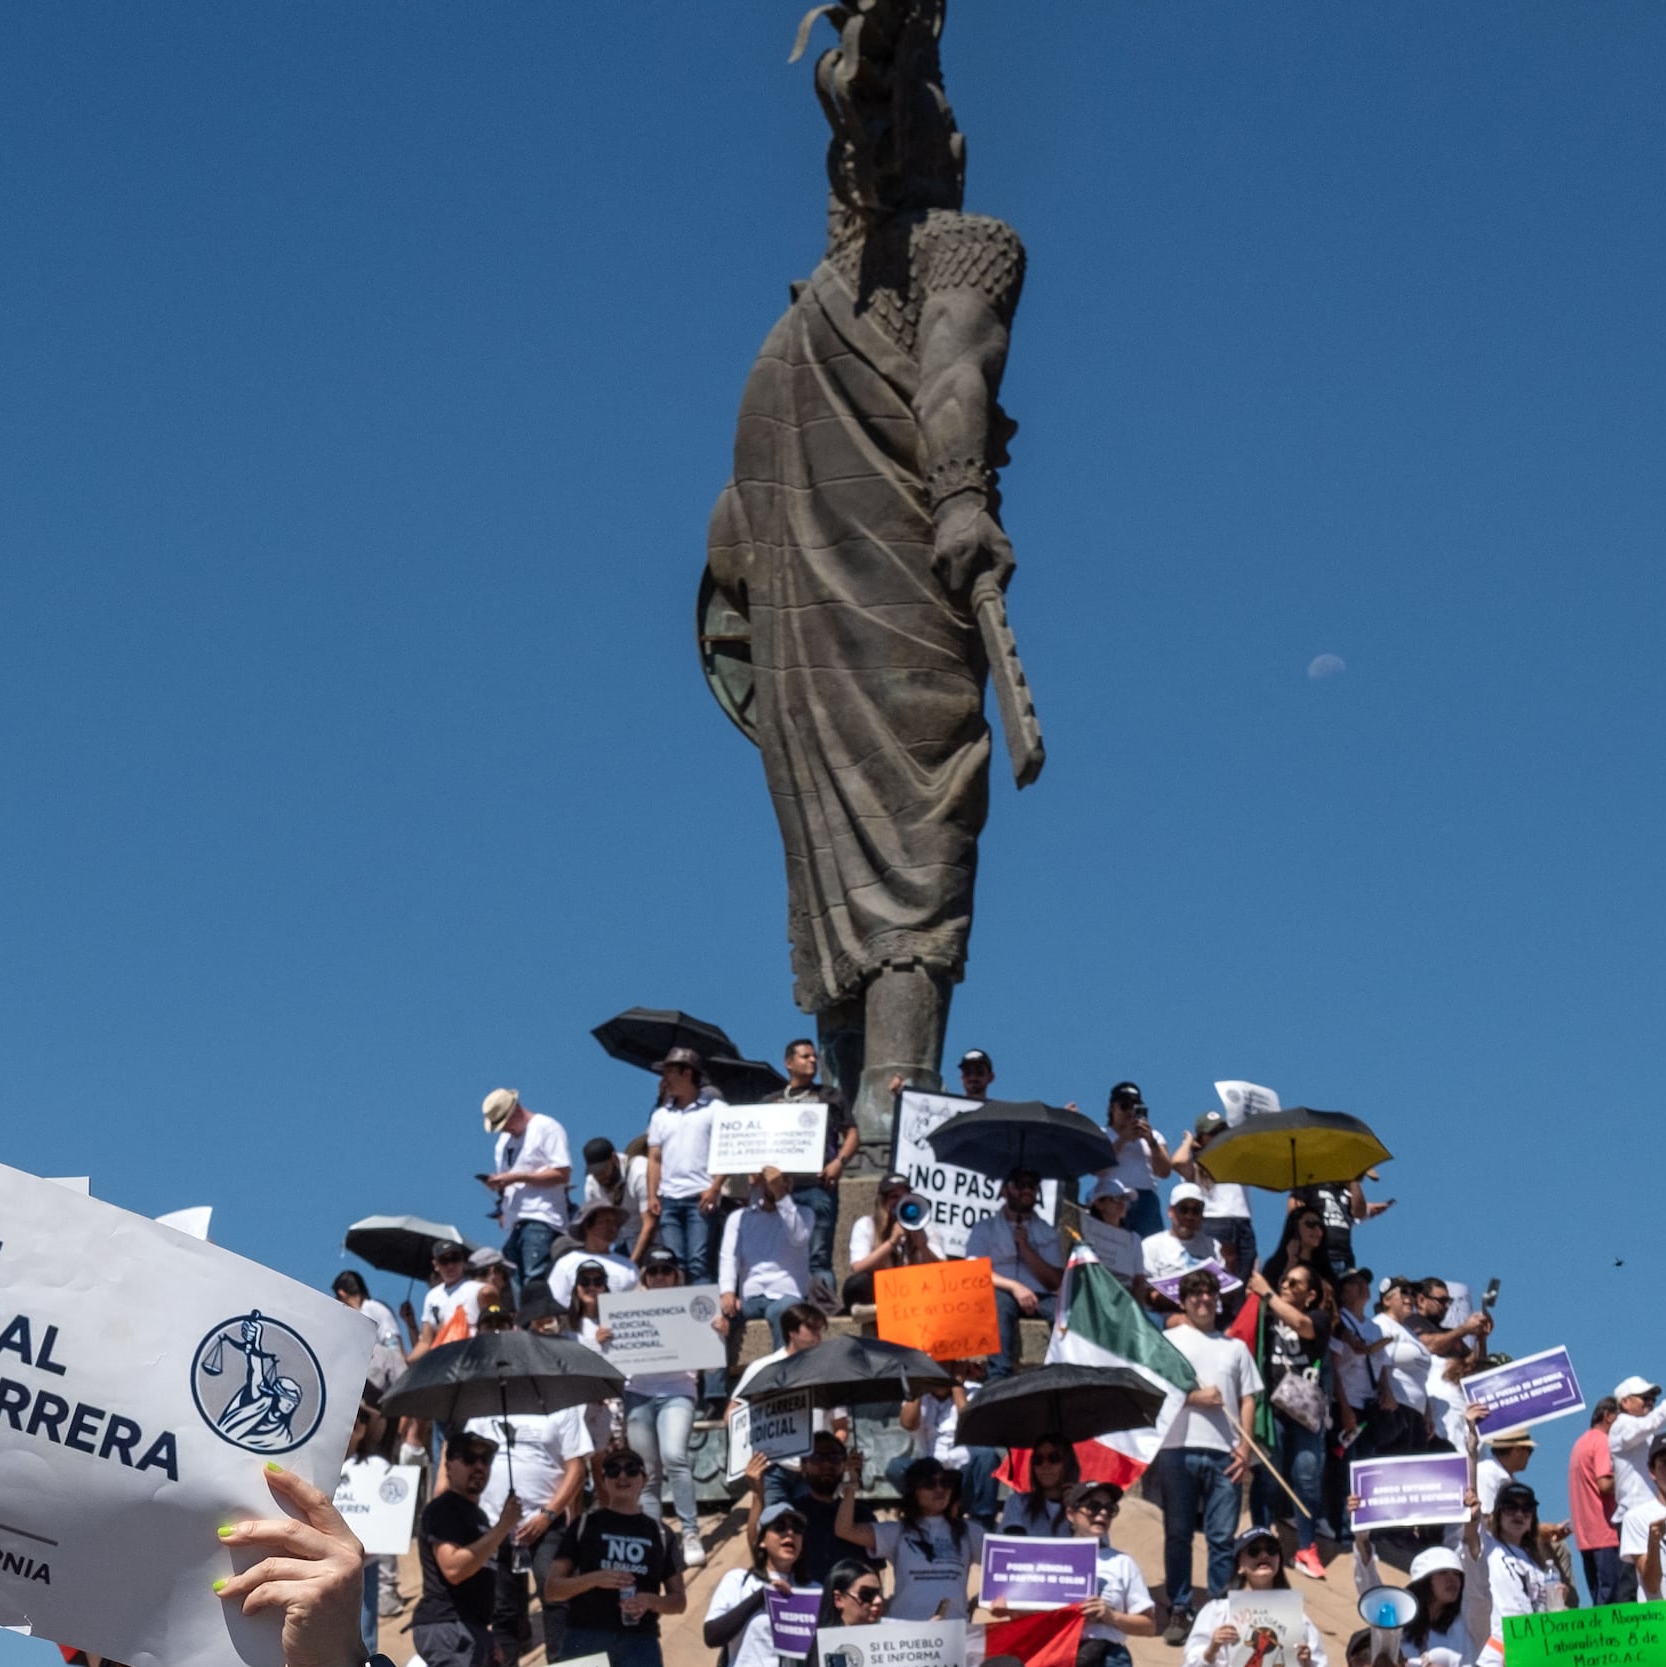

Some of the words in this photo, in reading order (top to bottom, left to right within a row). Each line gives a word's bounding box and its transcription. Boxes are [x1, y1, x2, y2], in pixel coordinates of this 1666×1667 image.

[909, 1164, 946, 1192] ¡NO
[608, 1306, 686, 1320] INDEPENDENCIA
[607, 1540, 647, 1564] NO
[1510, 1620, 1534, 1641] LA
[1588, 1611, 1603, 1629] de
[883, 1641, 895, 1652] EL
[898, 1638, 944, 1651] PUEBLO
[1643, 1630, 1659, 1645] de
[870, 1655, 885, 1665] SE
[887, 1651, 942, 1664] INFORMA
